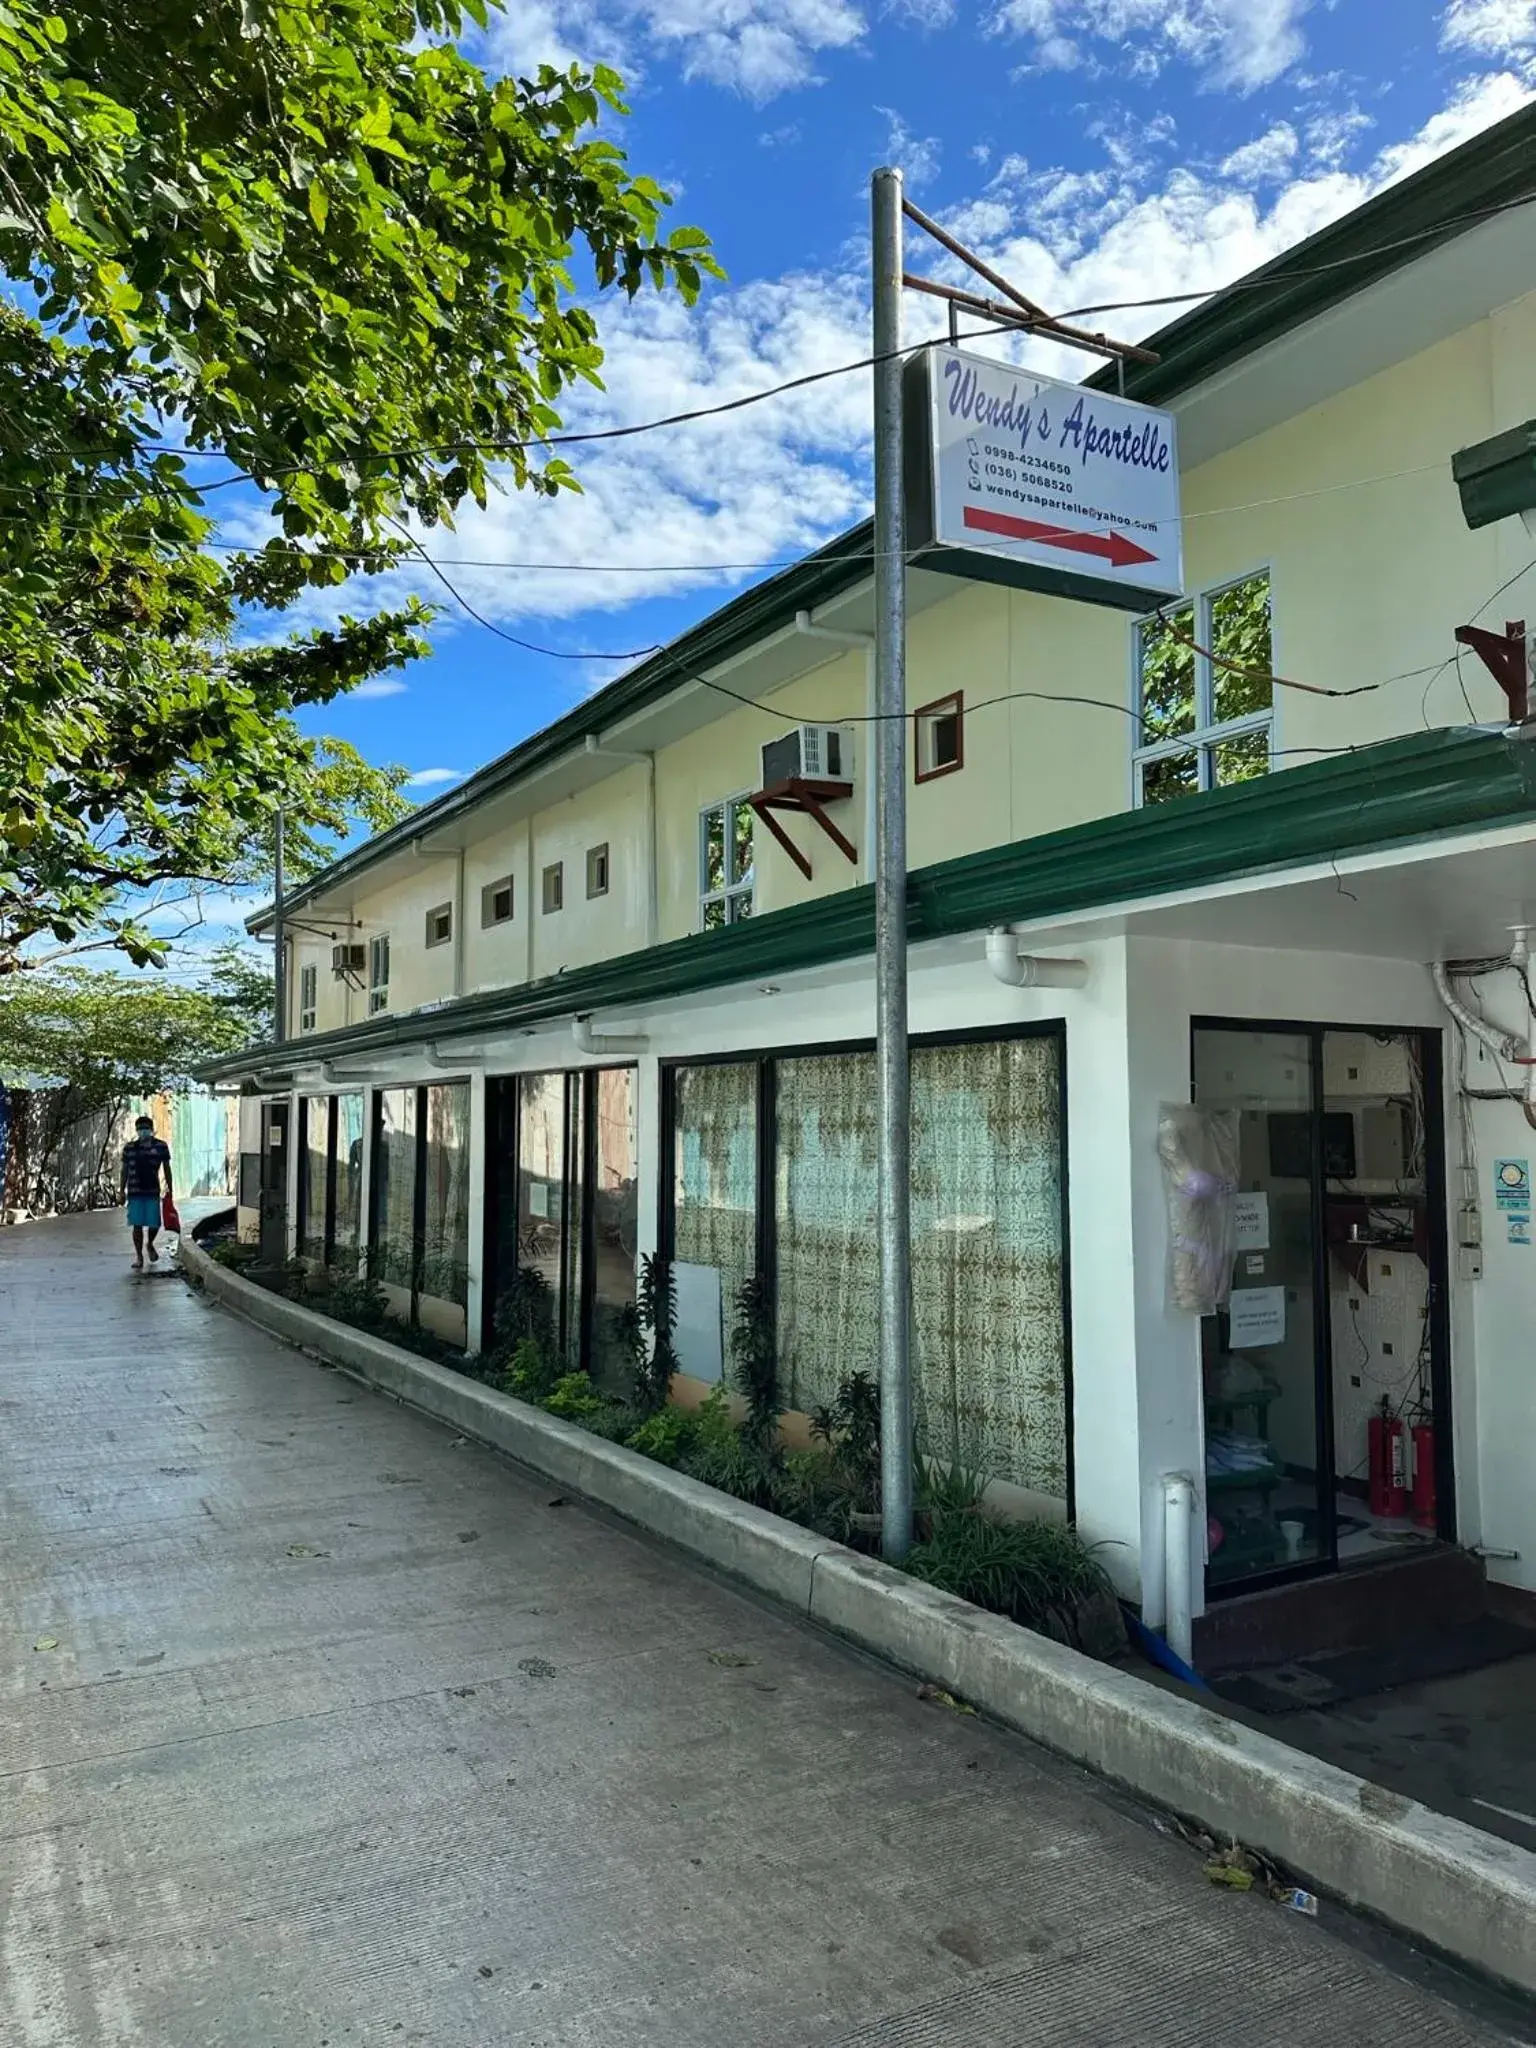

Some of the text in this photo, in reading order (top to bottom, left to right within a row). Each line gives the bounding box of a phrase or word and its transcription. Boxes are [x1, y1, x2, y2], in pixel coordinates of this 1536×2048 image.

[944, 360, 1170, 473] Wendy's Apartelle
[984, 463, 1073, 494] (036) 5068520
